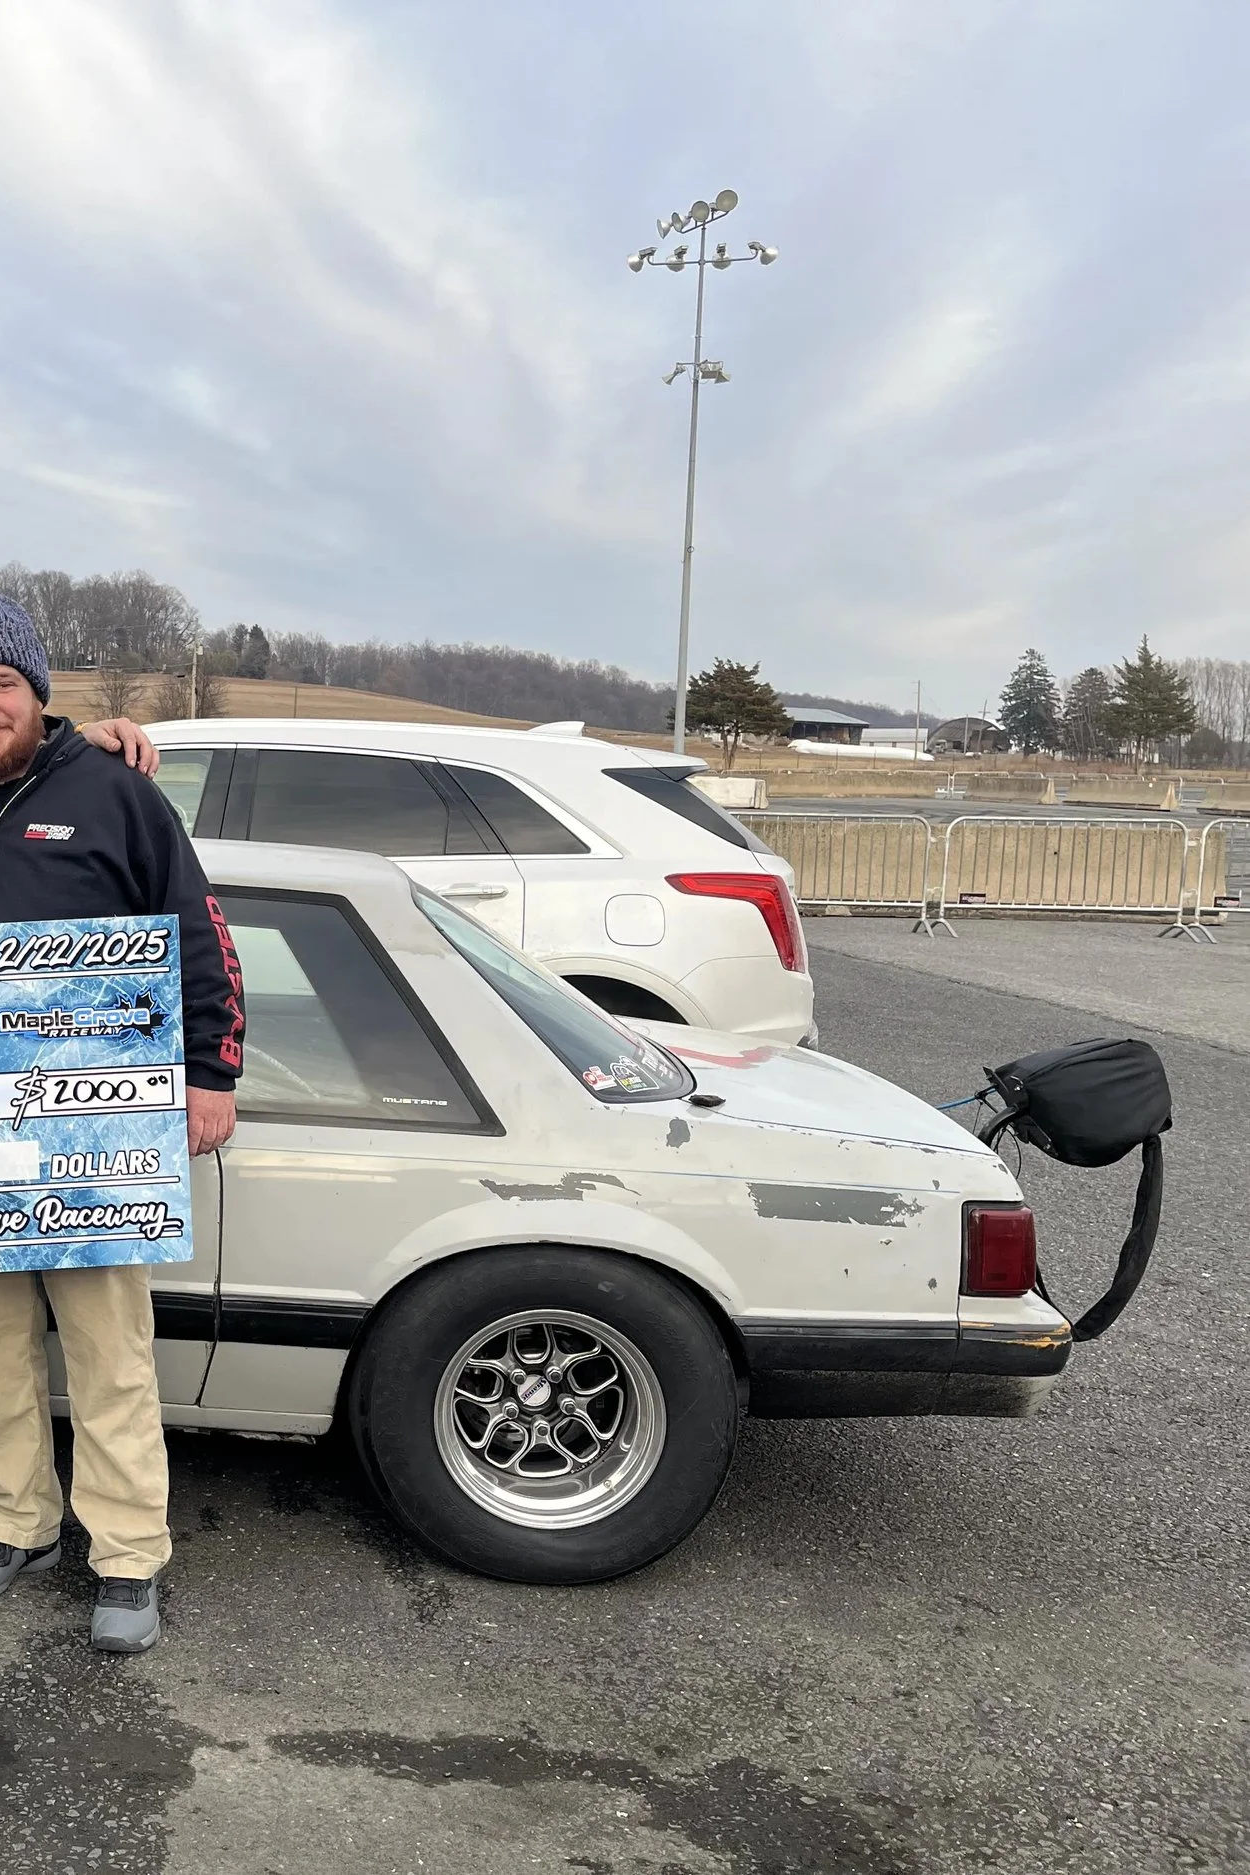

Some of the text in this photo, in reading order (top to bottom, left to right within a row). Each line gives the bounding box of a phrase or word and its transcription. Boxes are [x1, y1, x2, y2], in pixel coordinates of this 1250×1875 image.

[1, 1008, 150, 1032] MapleGrove
[48, 1026, 123, 1038] RACEWAY
[50, 1149, 161, 1180] DOLLARS
[36, 1198, 182, 1240] Raceway
